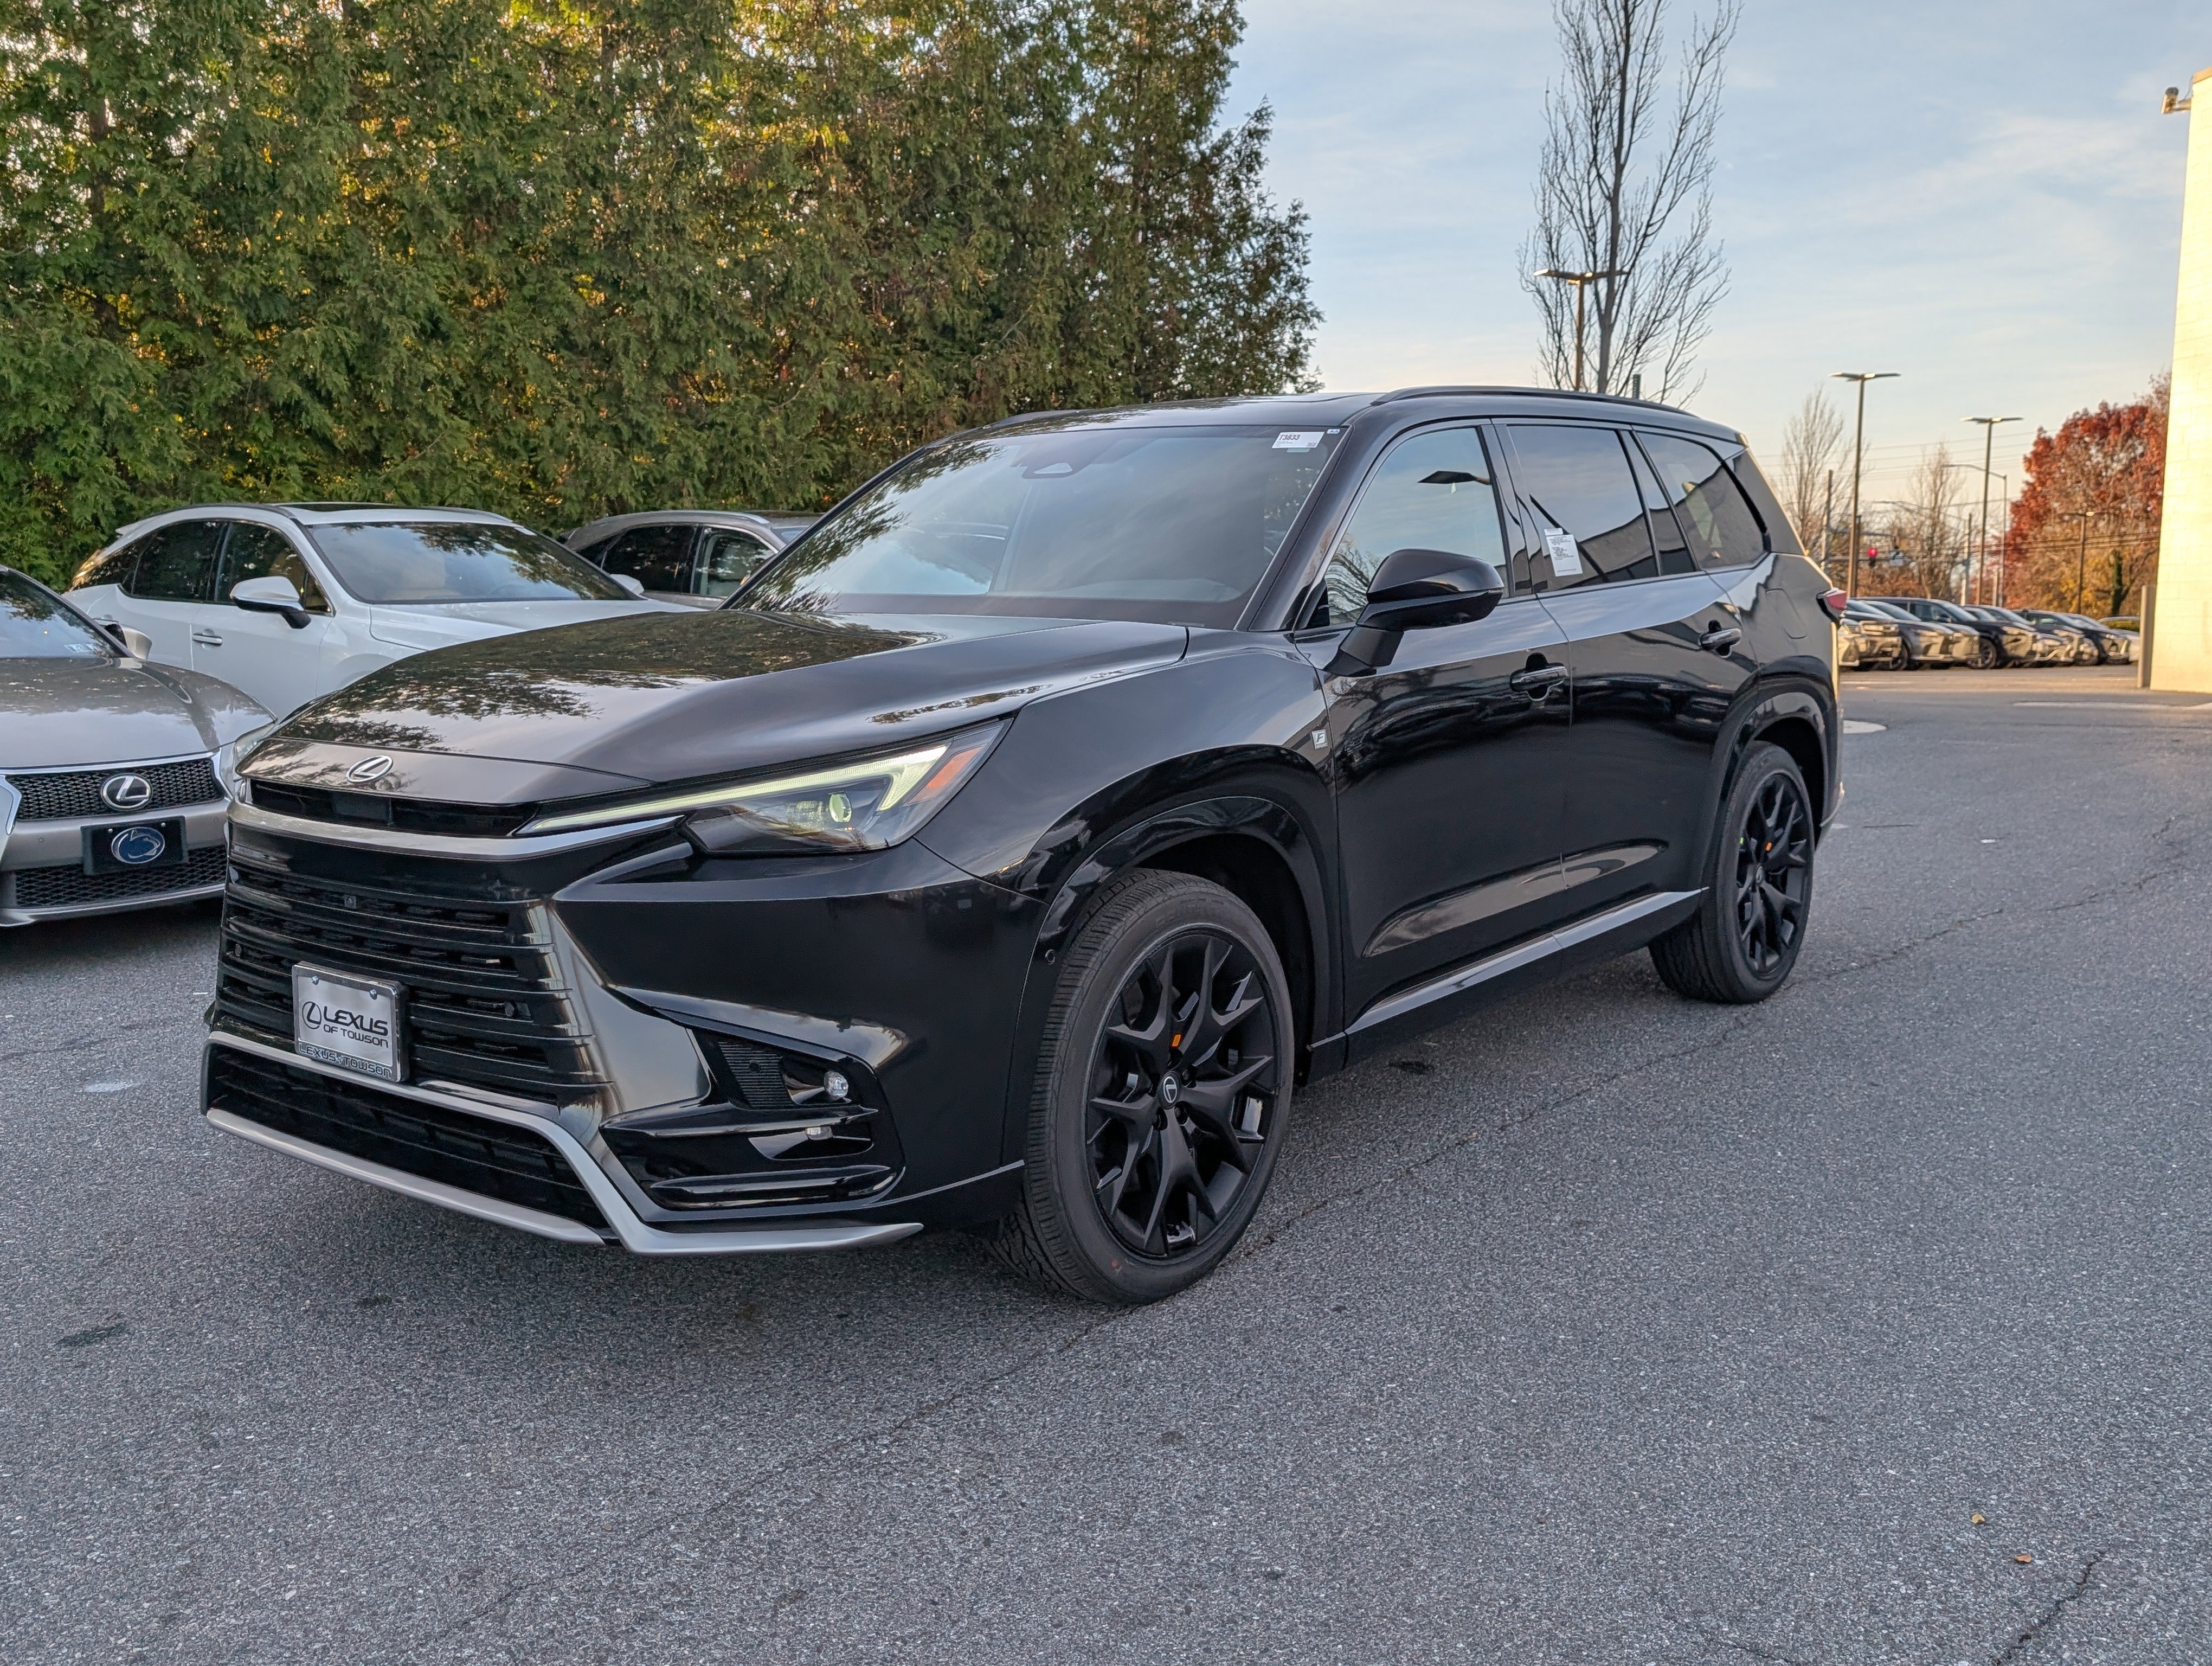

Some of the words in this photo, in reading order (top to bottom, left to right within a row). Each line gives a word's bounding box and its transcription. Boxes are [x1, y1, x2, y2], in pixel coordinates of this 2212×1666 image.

[323, 1005, 388, 1036] LEXUS
[324, 1024, 338, 1033] OF
[340, 1028, 389, 1048] TOWSON
[299, 1043, 337, 1062] LEXUS
[343, 1056, 392, 1079] TOWSON
